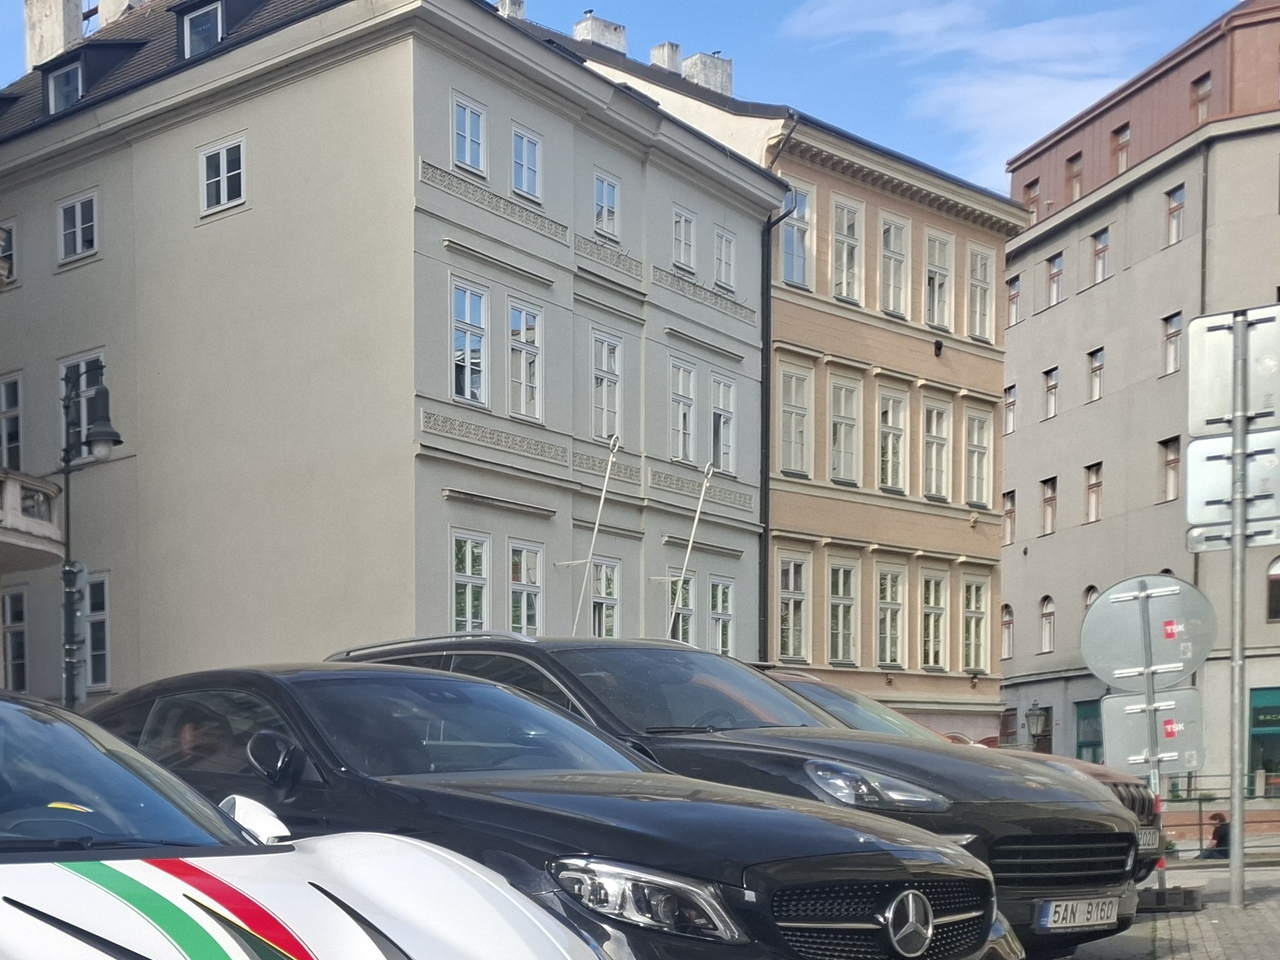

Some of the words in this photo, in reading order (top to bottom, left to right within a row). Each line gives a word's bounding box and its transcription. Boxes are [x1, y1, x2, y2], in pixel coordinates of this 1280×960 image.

[1165, 624, 1185, 633] TSK
[1165, 723, 1185, 732] TSK
[1052, 903, 1078, 924] 5AN
[1086, 901, 1113, 922] 9160
